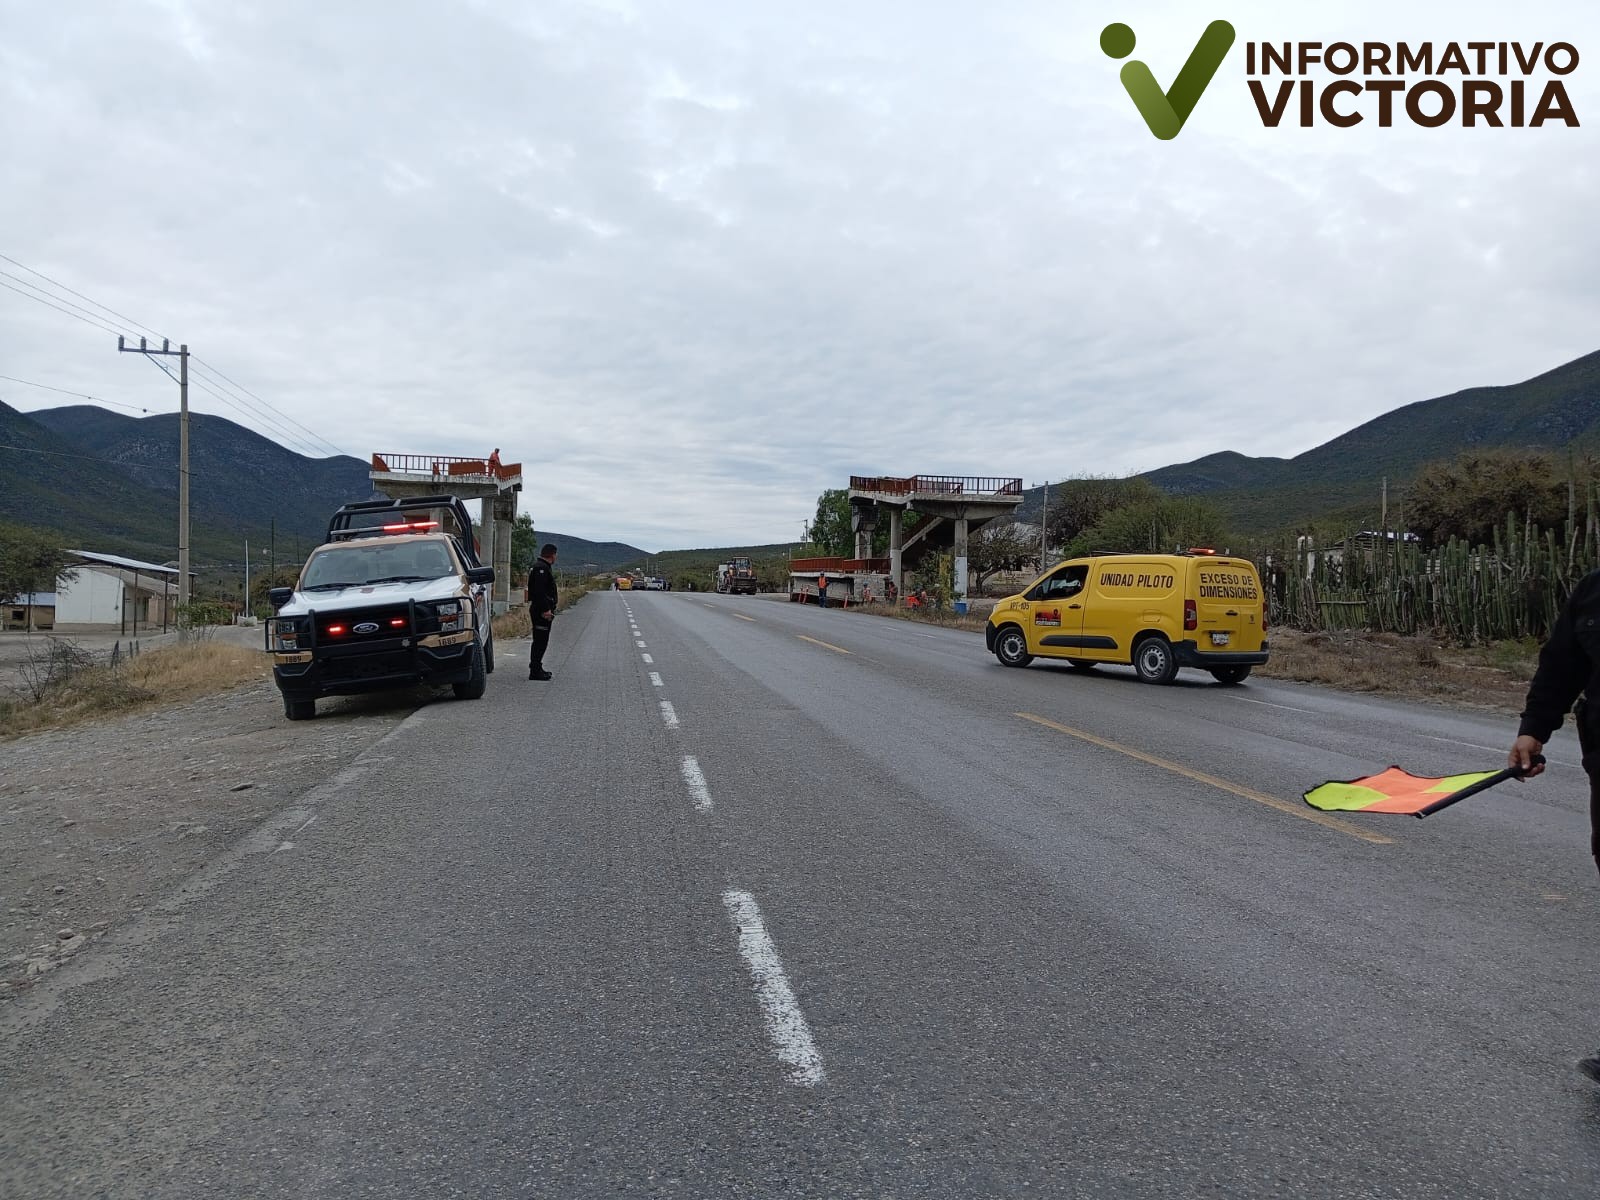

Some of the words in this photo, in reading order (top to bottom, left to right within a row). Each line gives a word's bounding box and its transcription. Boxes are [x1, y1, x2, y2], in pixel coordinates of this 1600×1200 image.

[1100, 572, 1134, 587] UNIDAD
[1137, 574, 1174, 589] PILOTO
[1199, 573, 1239, 584] EXCESO
[1241, 575, 1254, 586] DE
[1199, 585, 1258, 599] DIMENSIONES
